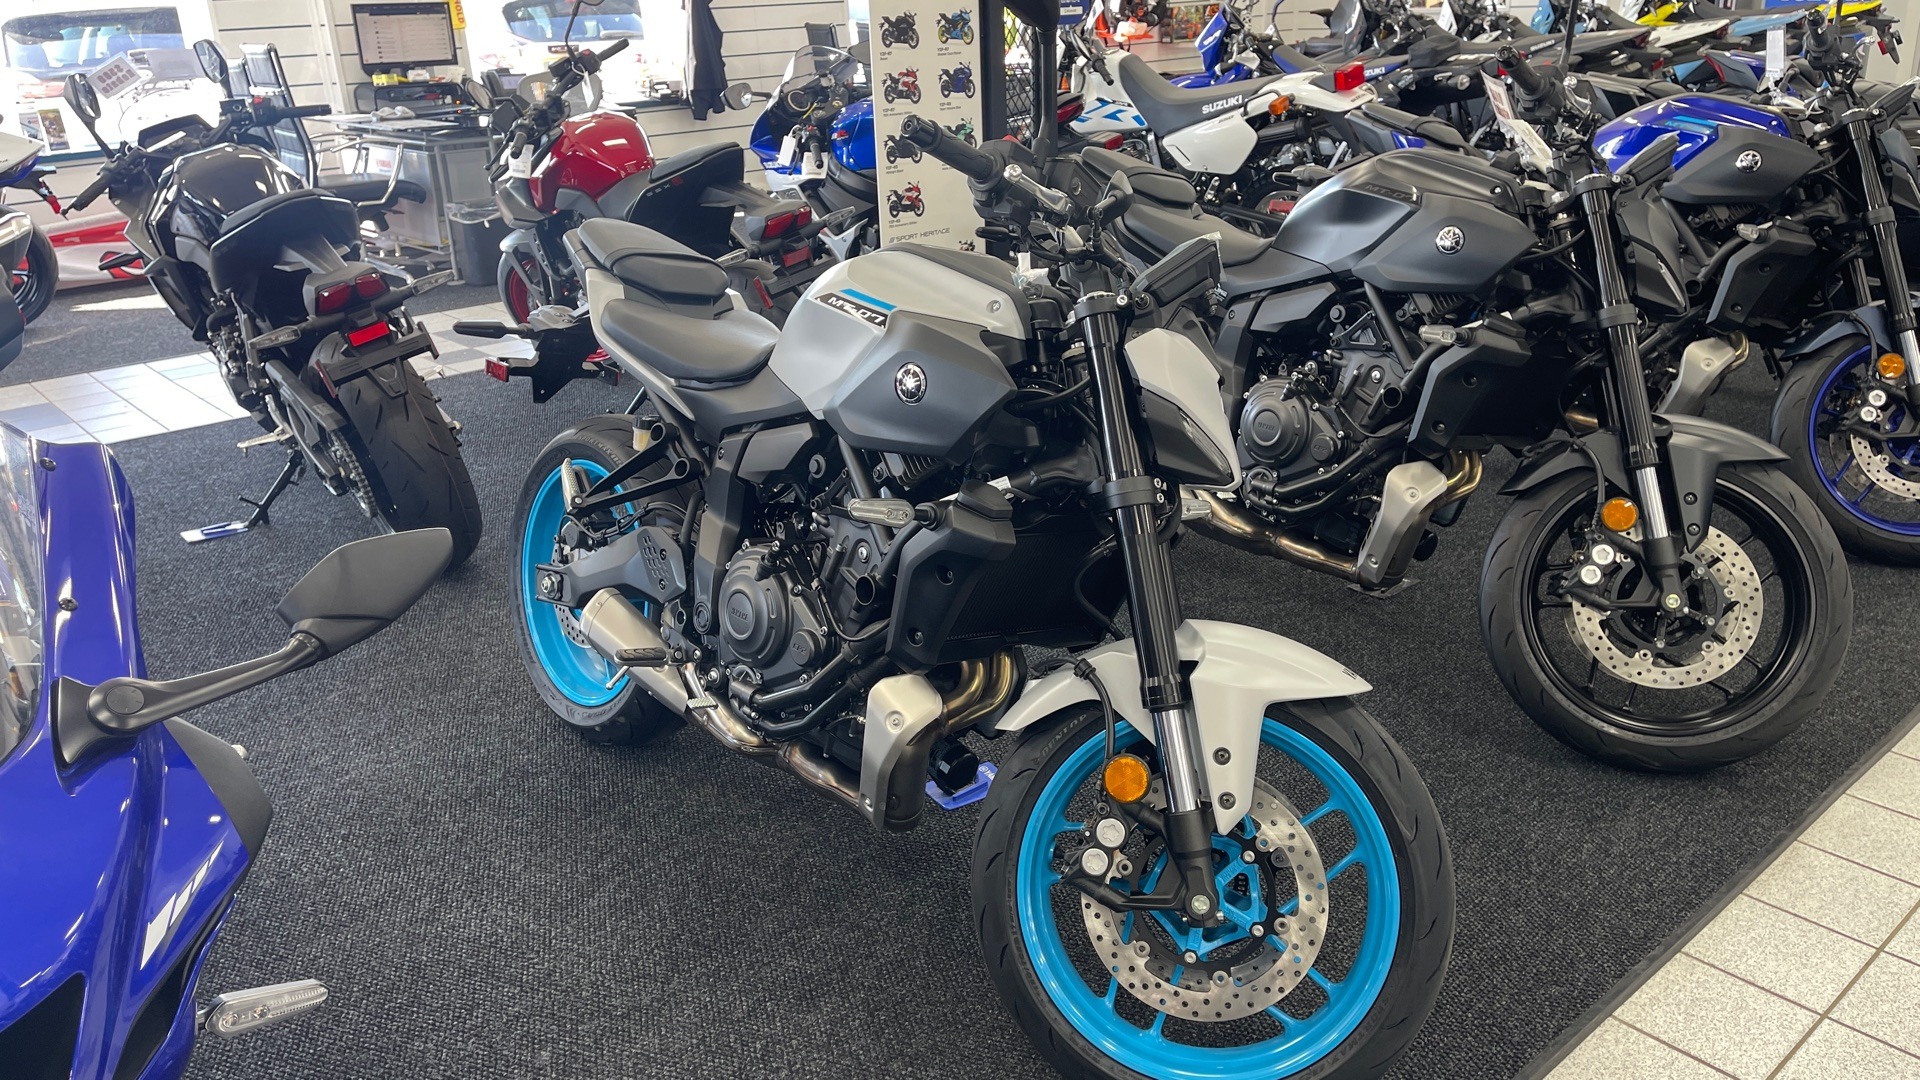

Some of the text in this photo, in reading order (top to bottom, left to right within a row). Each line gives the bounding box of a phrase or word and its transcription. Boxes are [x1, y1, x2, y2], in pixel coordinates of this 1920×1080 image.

[1202, 94, 1243, 114] SUZUKI
[895, 228, 951, 242] SPORT HERITAGE
